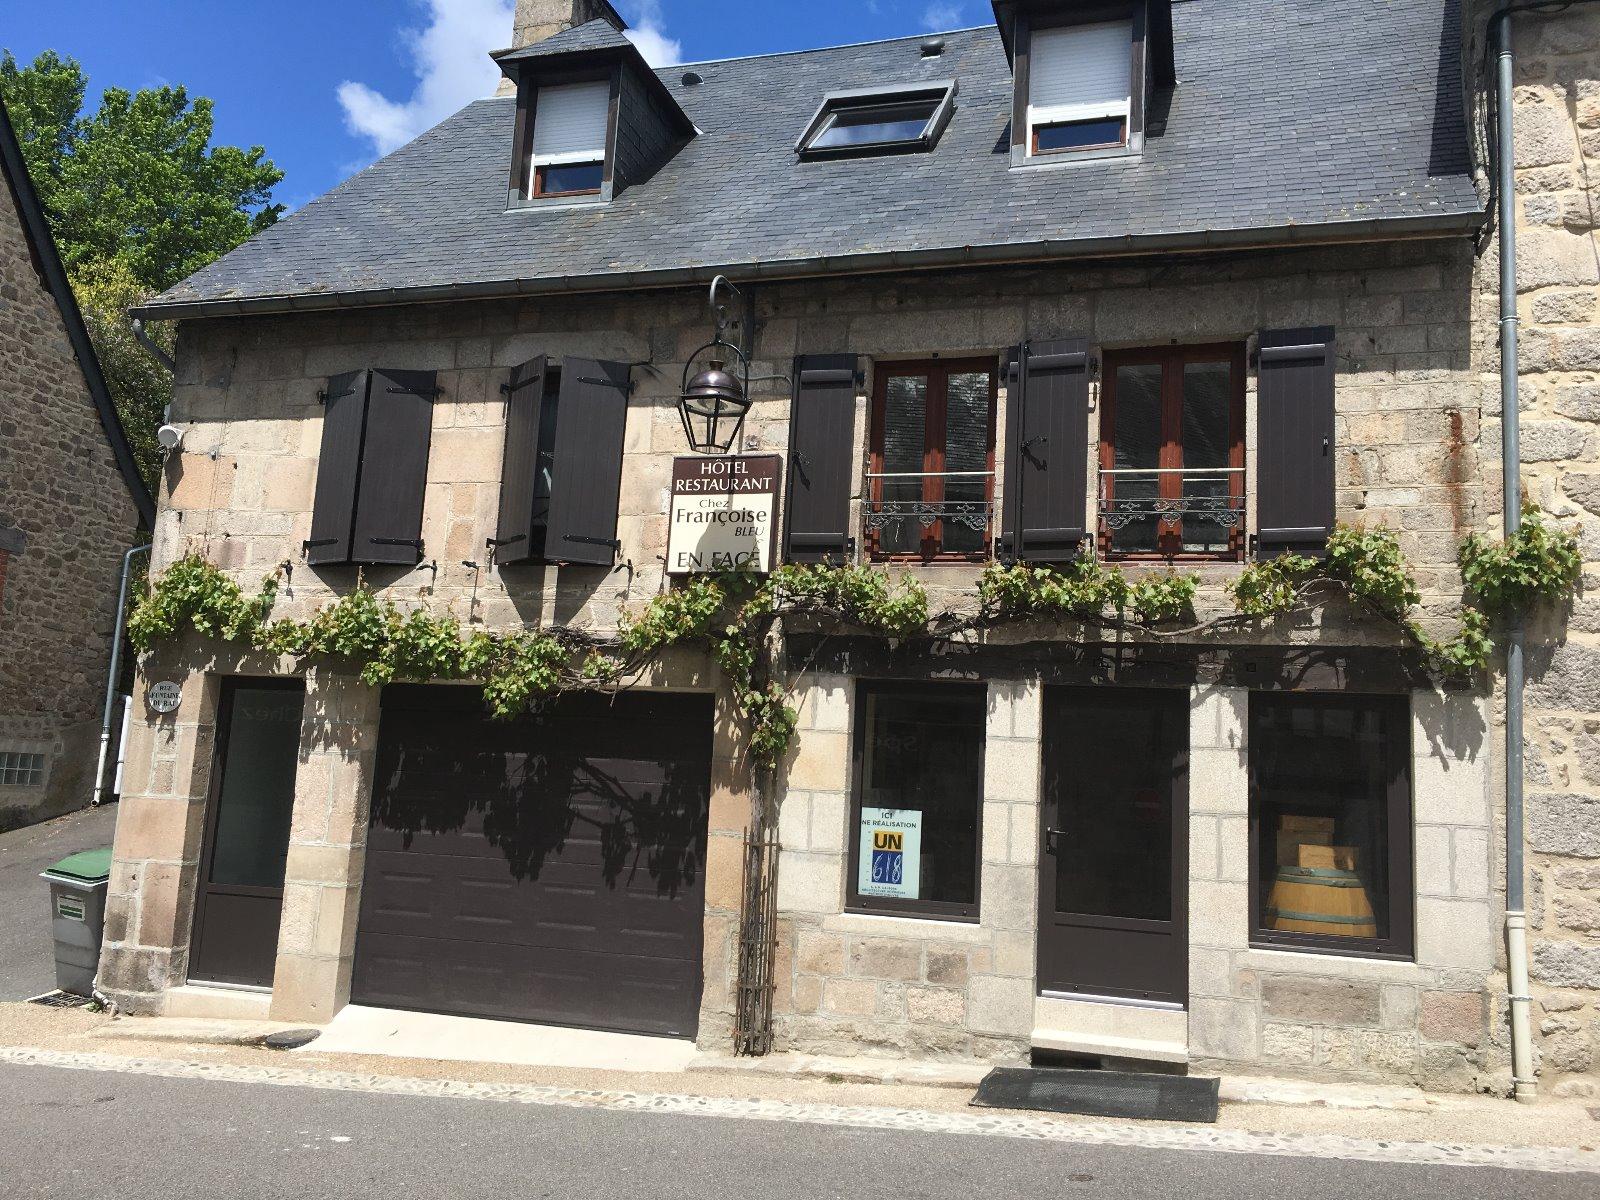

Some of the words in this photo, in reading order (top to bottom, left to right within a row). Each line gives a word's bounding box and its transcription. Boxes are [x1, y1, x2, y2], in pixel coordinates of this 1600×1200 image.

[701, 458, 749, 475] HÔTEL
[675, 477, 773, 491] RESTAURANT
[699, 498, 730, 509] Chez
[676, 507, 767, 527] Françoise
[734, 526, 765, 537] BLEU
[677, 551, 703, 568] EN
[872, 819, 917, 828] RÉALISATION
[874, 833, 902, 850] UN
[872, 853, 902, 883] 618
